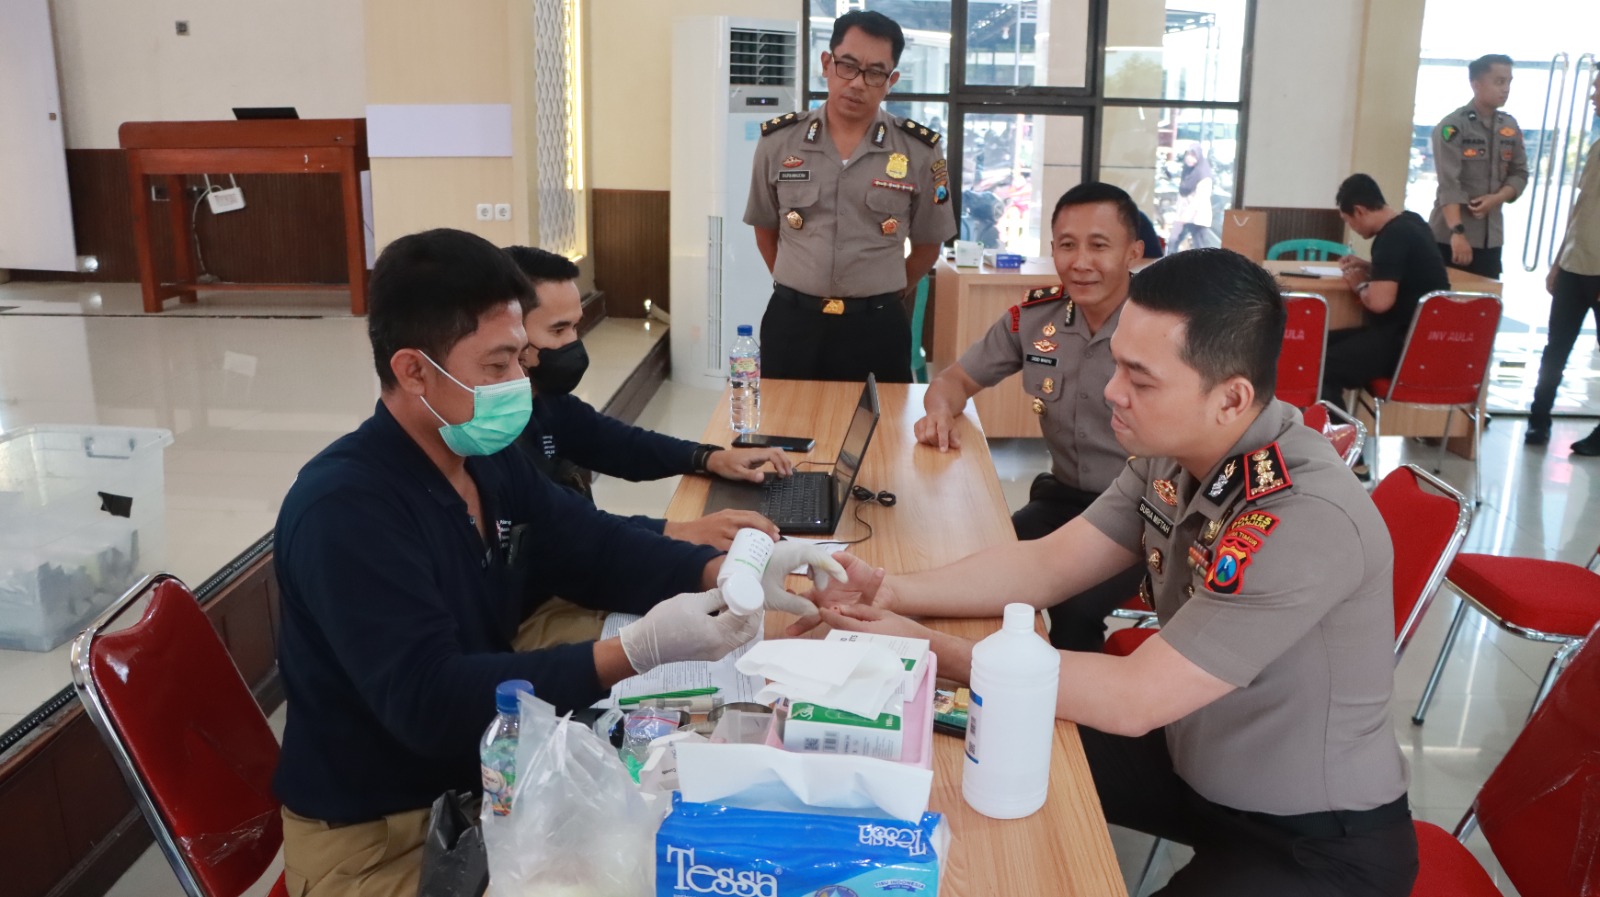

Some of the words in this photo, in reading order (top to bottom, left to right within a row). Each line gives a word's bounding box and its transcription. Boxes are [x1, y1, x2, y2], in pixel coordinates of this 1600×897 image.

[1284, 329, 1305, 340] ULA
[1448, 331, 1474, 343] AULA
[1239, 531, 1259, 547] TIMUR
[857, 823, 927, 857] Tessa
[666, 844, 778, 897] Tessa
